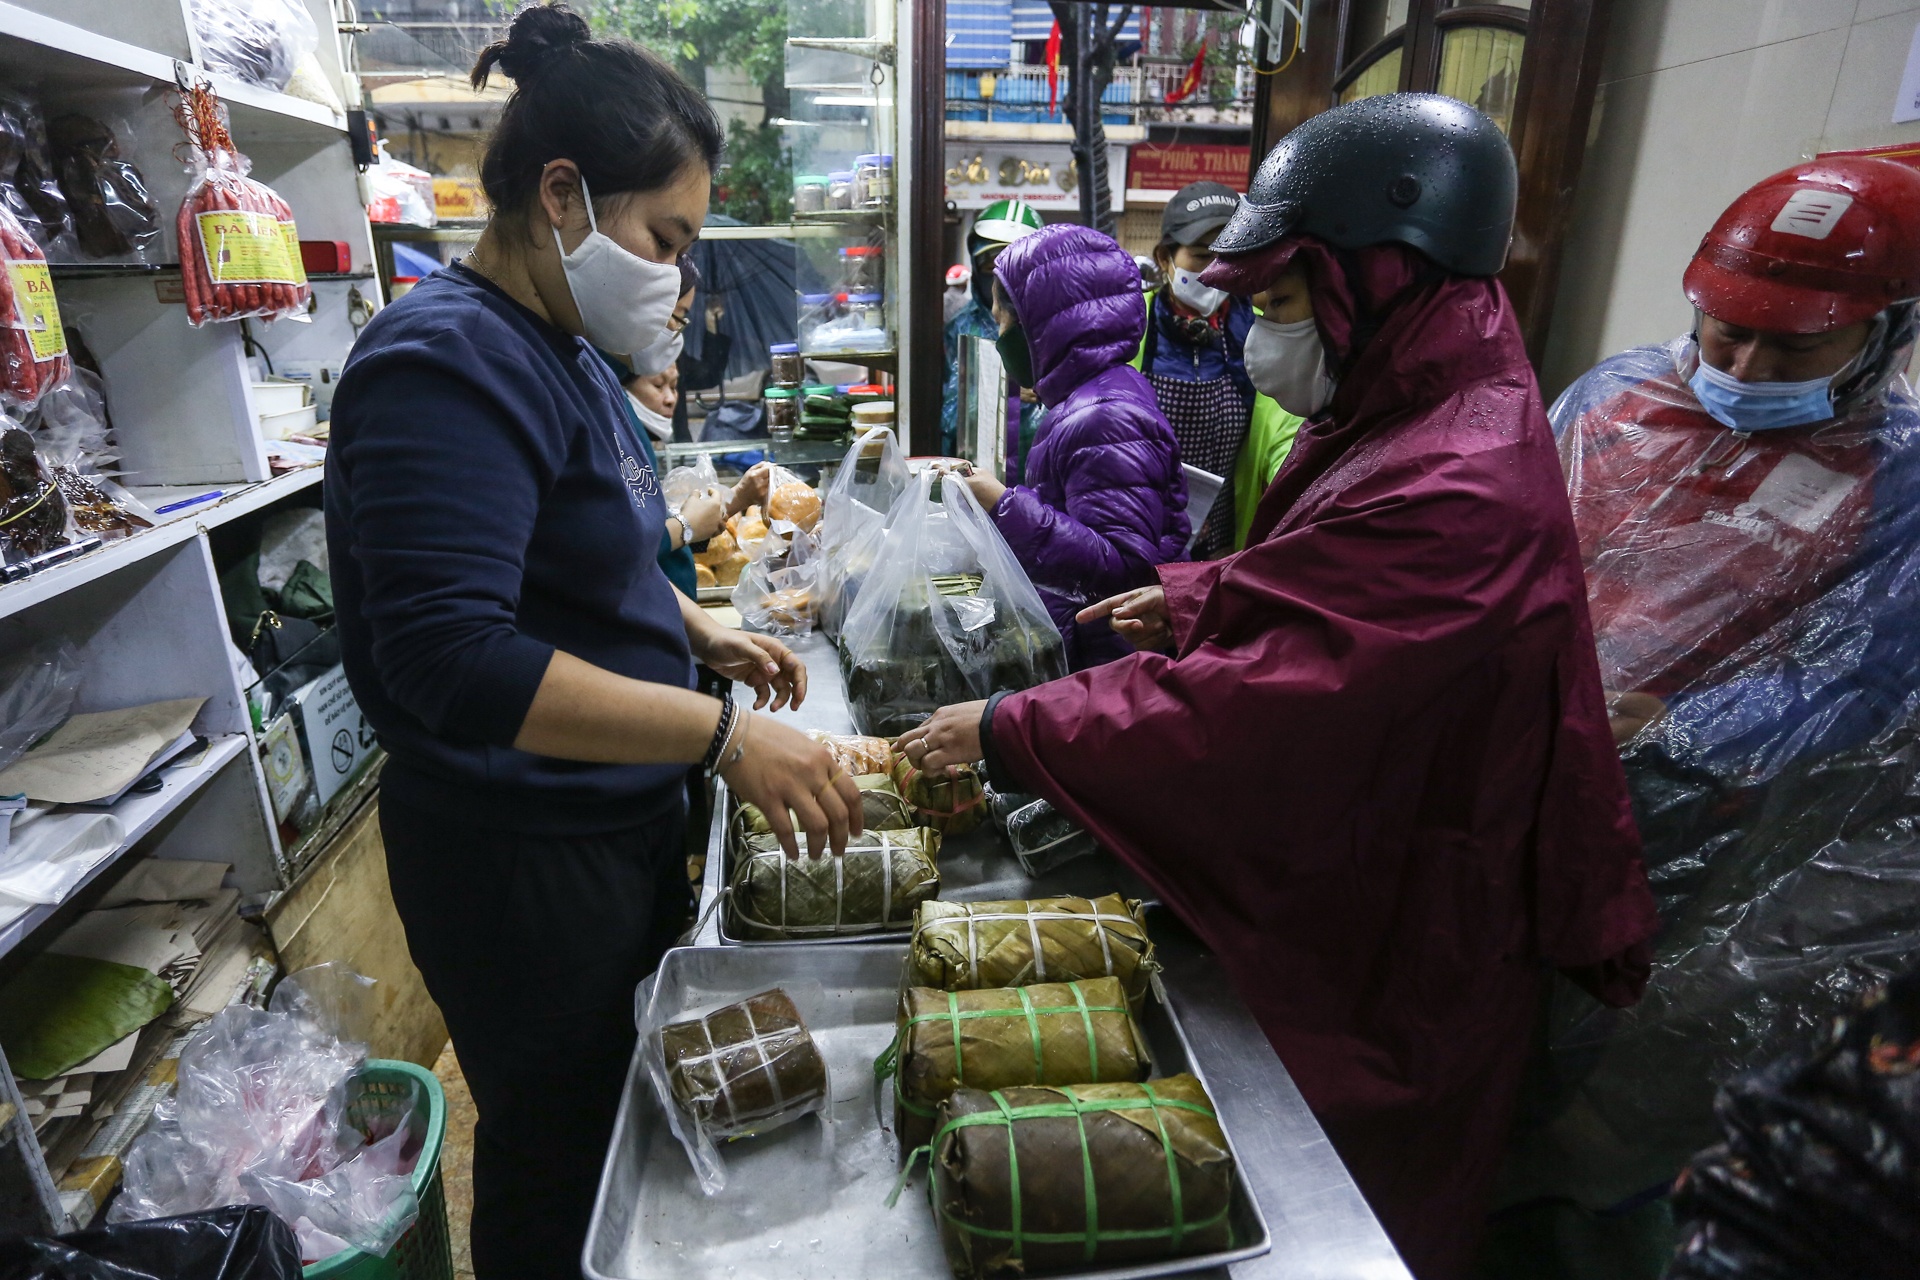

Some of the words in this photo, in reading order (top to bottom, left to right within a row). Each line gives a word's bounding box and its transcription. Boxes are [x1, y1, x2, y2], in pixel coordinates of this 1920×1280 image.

[1160, 147, 1199, 171] PHÚC
[213, 223, 242, 234] BÀ
[25, 277, 51, 293] BÀ
